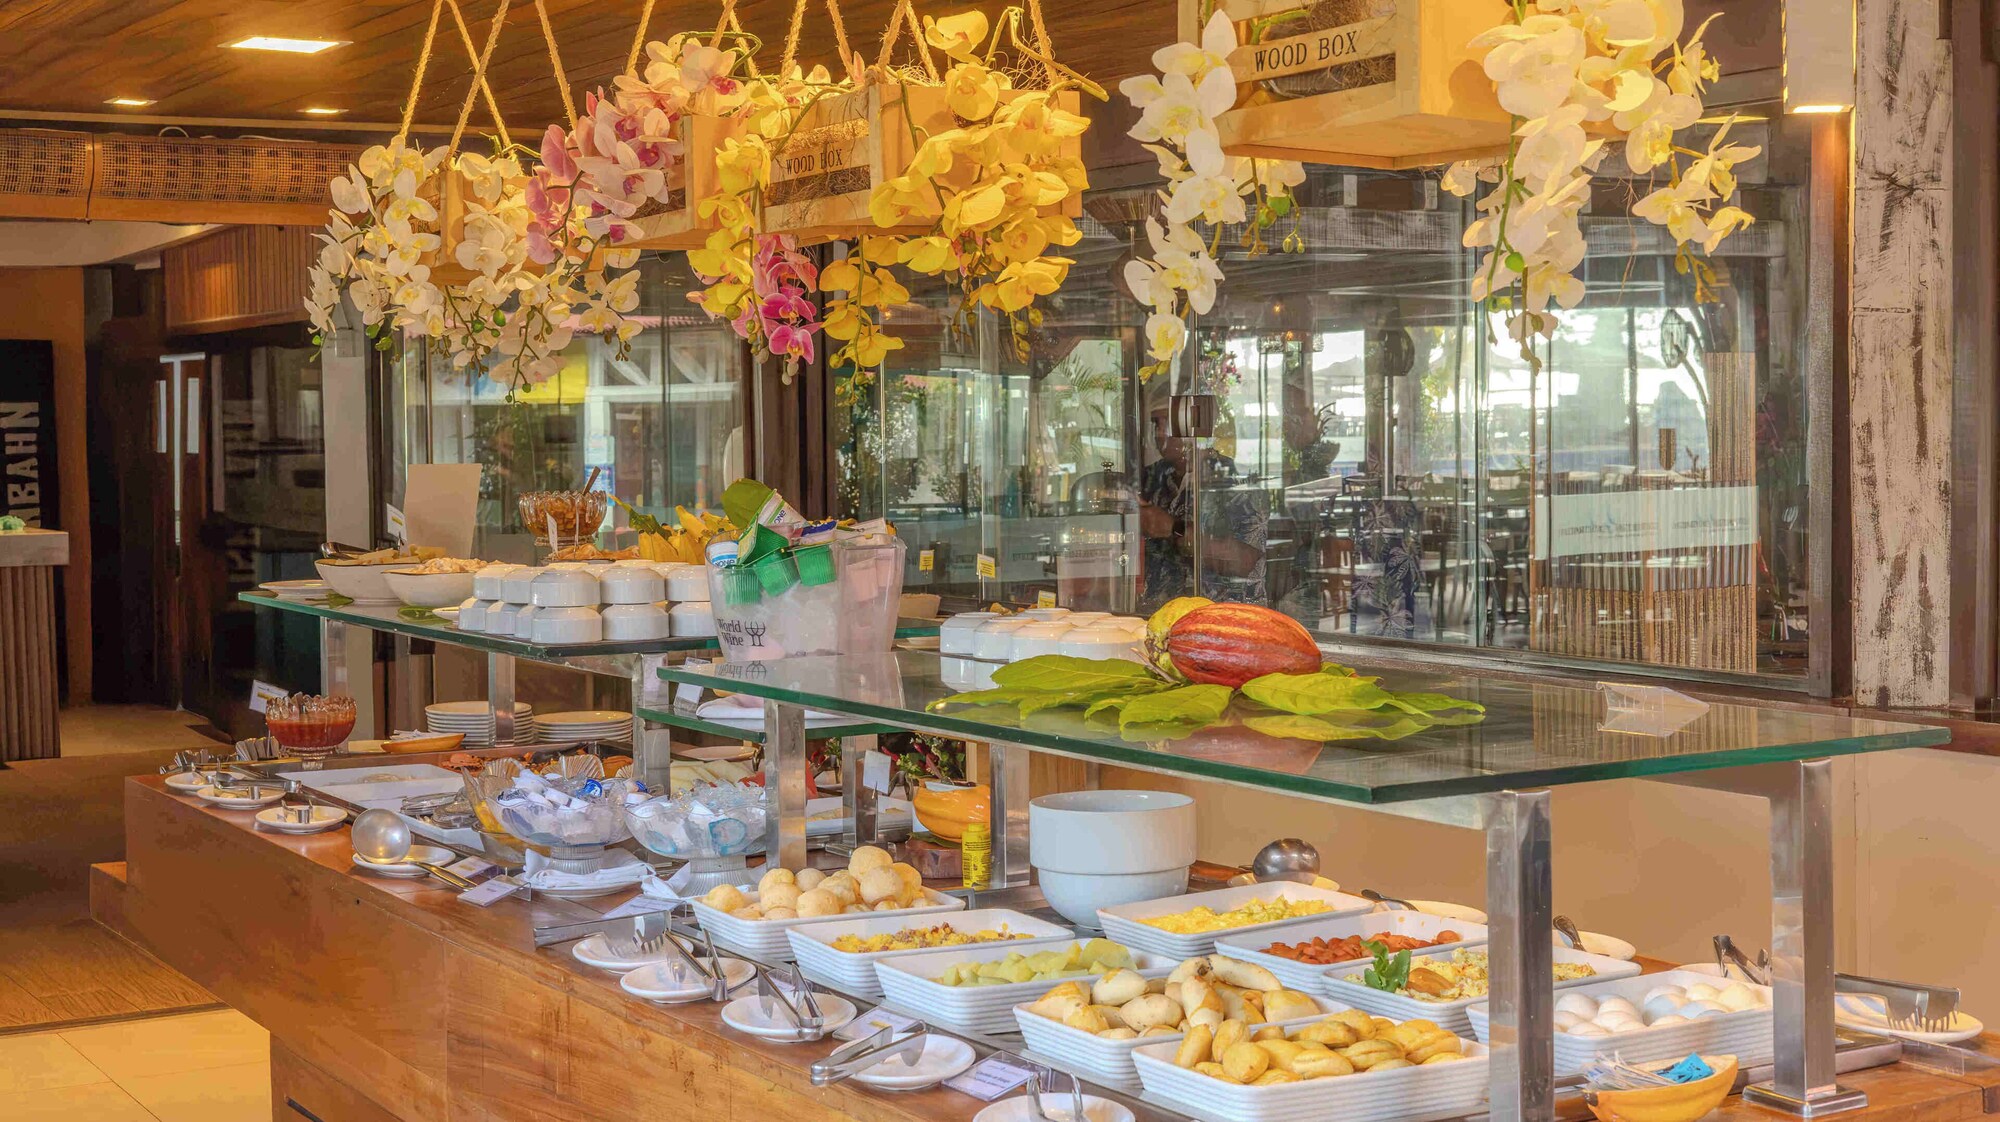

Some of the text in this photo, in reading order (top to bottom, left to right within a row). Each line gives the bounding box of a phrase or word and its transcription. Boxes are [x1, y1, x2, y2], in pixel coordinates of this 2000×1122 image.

[1255, 31, 1357, 72] WOOD BOX
[786, 149, 843, 175] WOOD BOX
[717, 618, 742, 634] World
[721, 631, 744, 647] Wine
